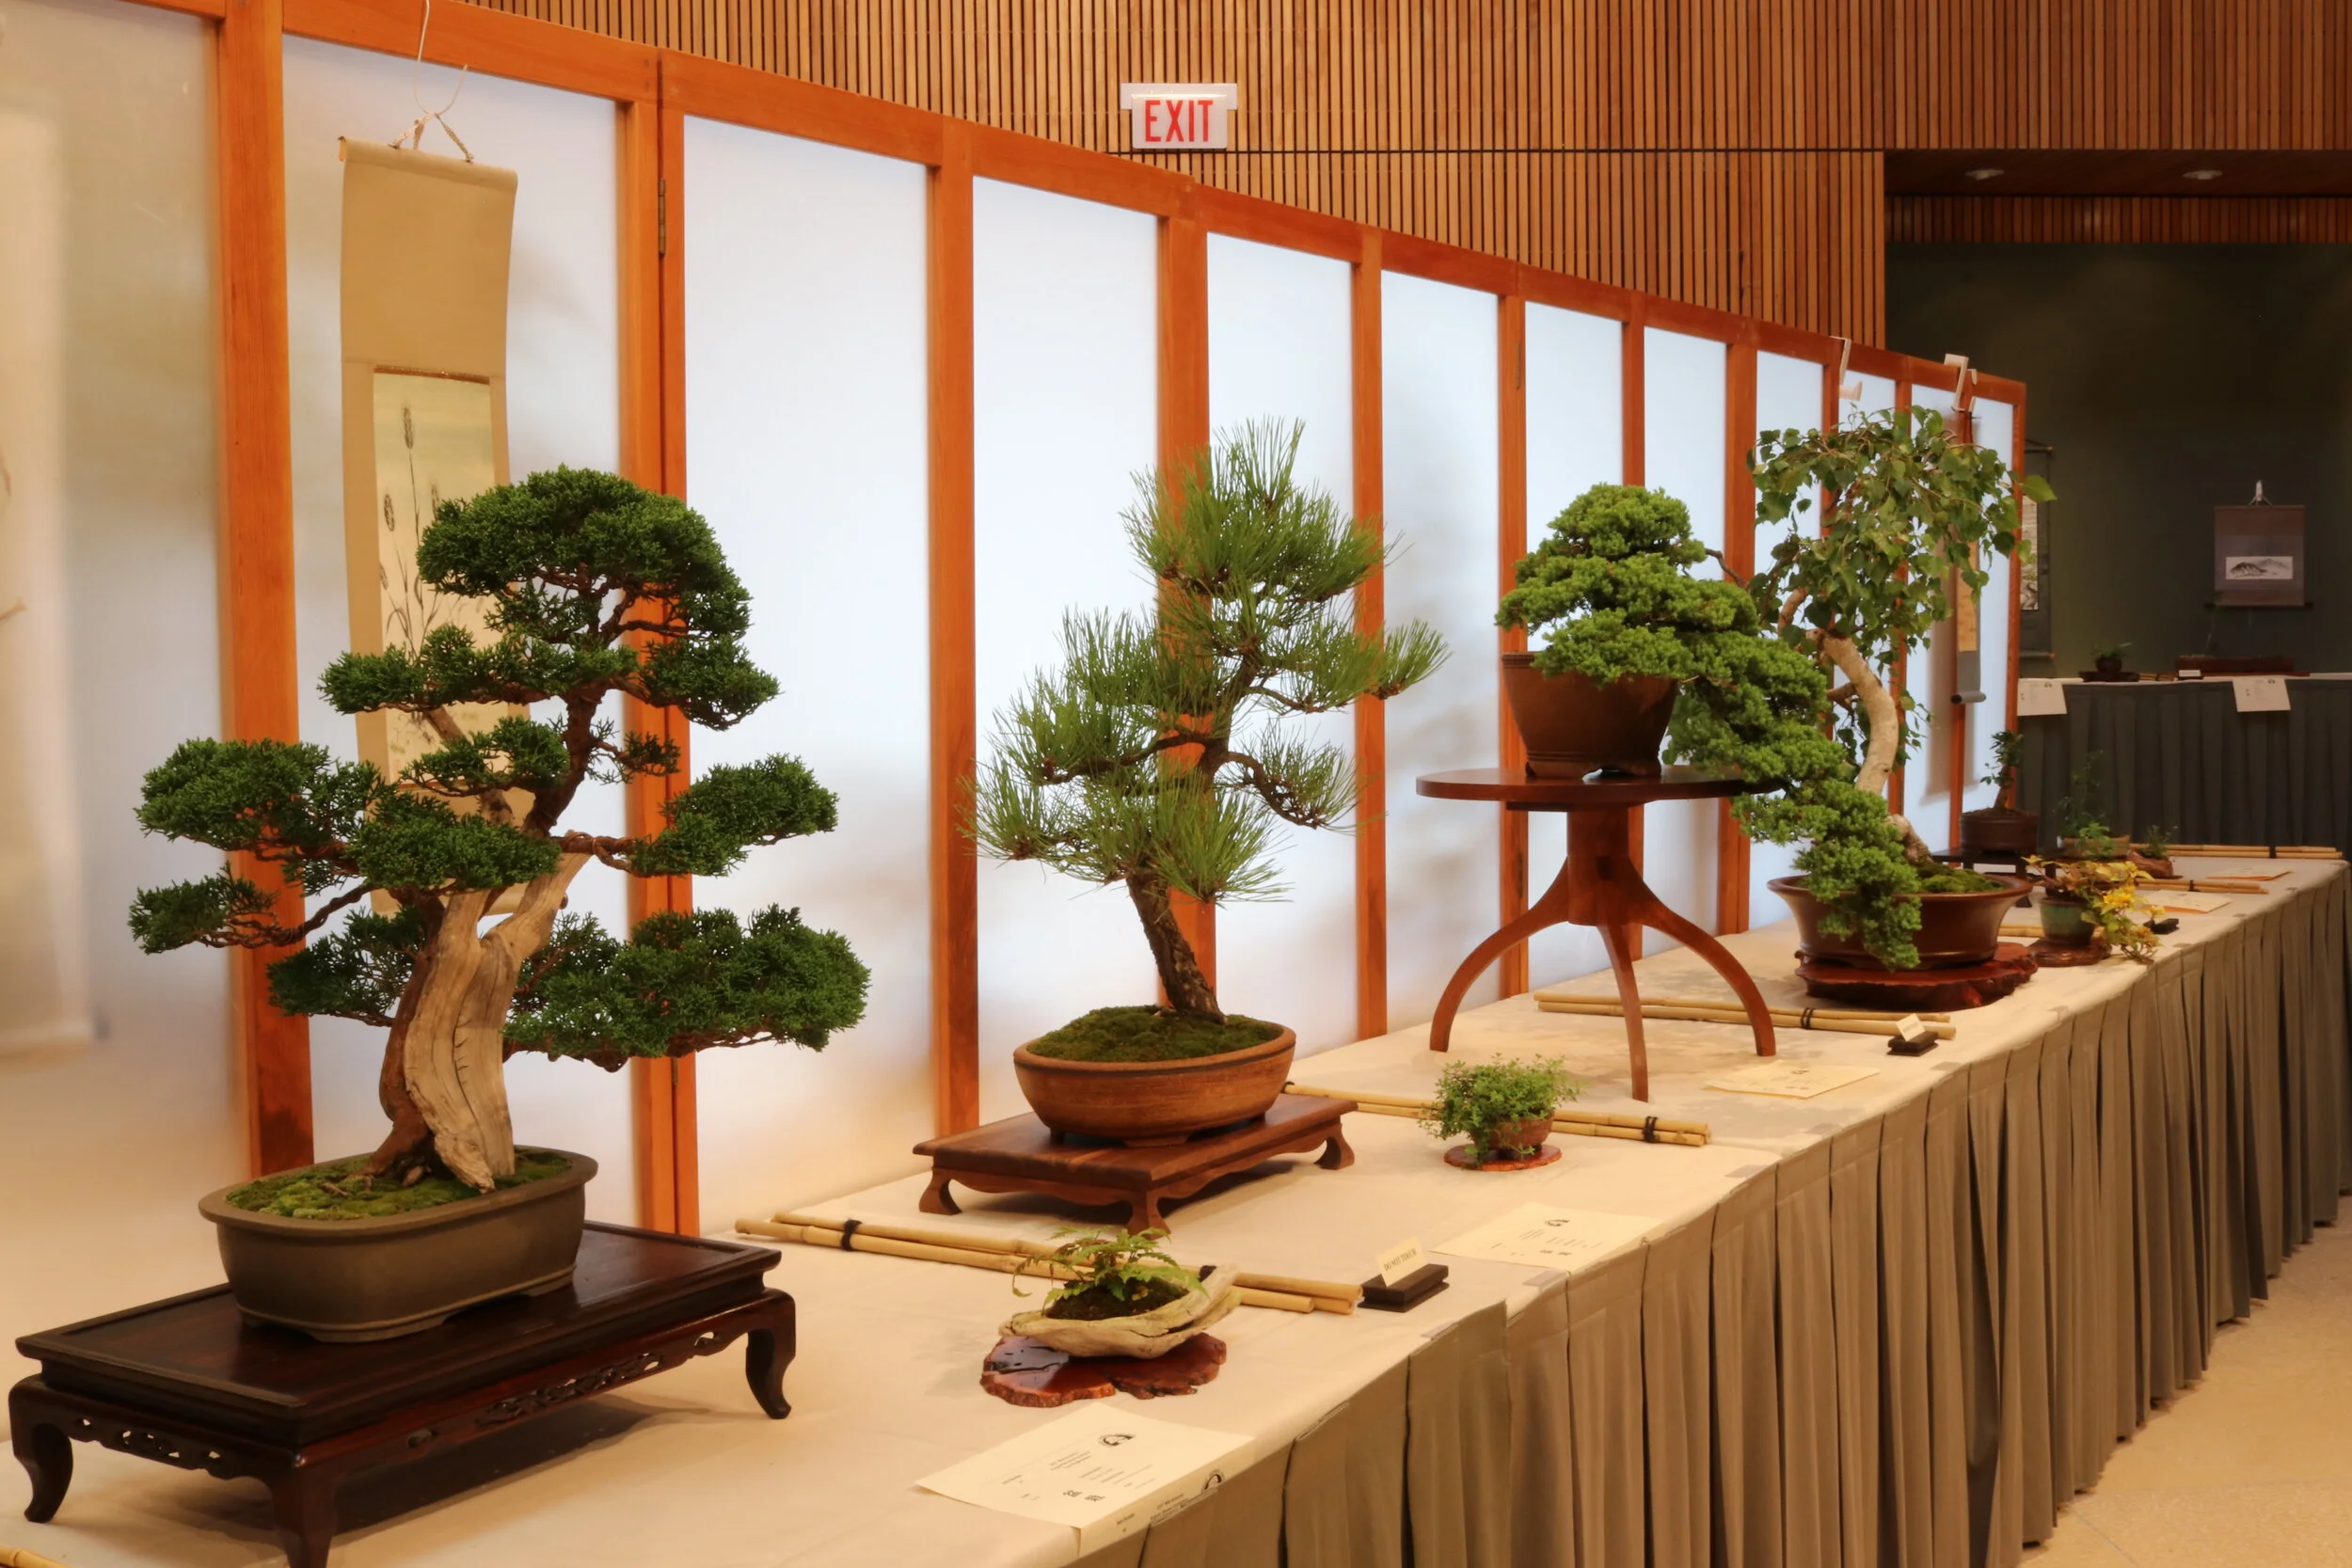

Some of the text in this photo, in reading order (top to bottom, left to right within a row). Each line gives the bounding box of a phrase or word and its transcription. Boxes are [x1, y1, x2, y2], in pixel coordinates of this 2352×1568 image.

[1145, 100, 1214, 142] EXIT
[1383, 1262, 1392, 1272] DO
[1391, 1255, 1402, 1267] NOT
